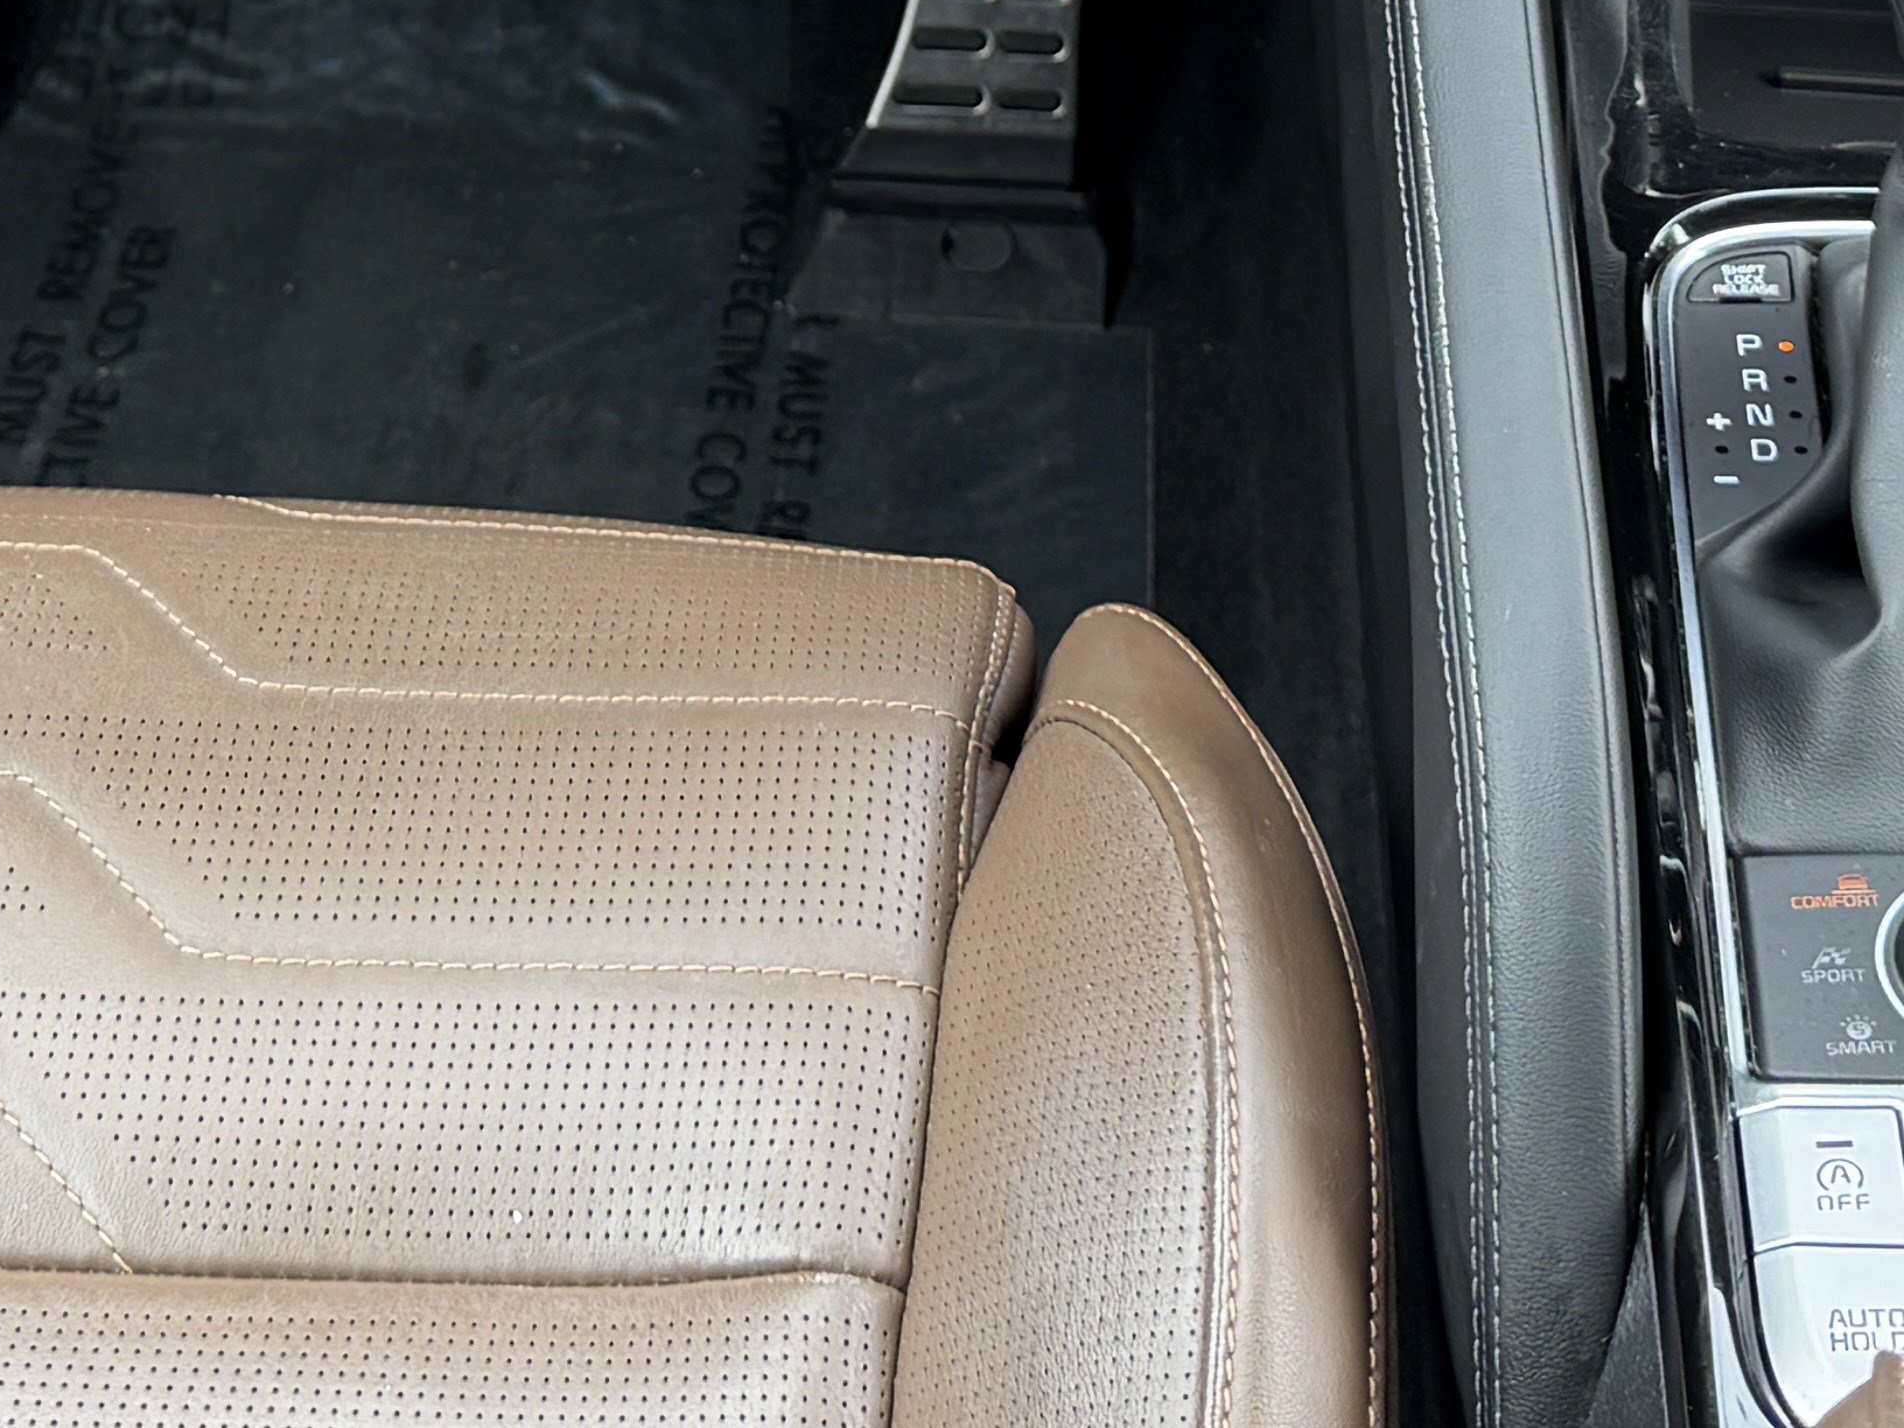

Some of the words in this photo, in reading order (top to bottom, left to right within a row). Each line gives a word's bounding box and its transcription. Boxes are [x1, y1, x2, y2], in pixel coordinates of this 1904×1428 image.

[1736, 333, 1763, 357] P
[1742, 368, 1769, 392] R
[1746, 402, 1774, 426] N
[1751, 438, 1779, 463] D
[1790, 891, 1879, 910] COMFORT
[1800, 968, 1865, 985] SPORT
[1825, 1039, 1896, 1057] SMART
[1816, 1193, 1871, 1212] OFF
